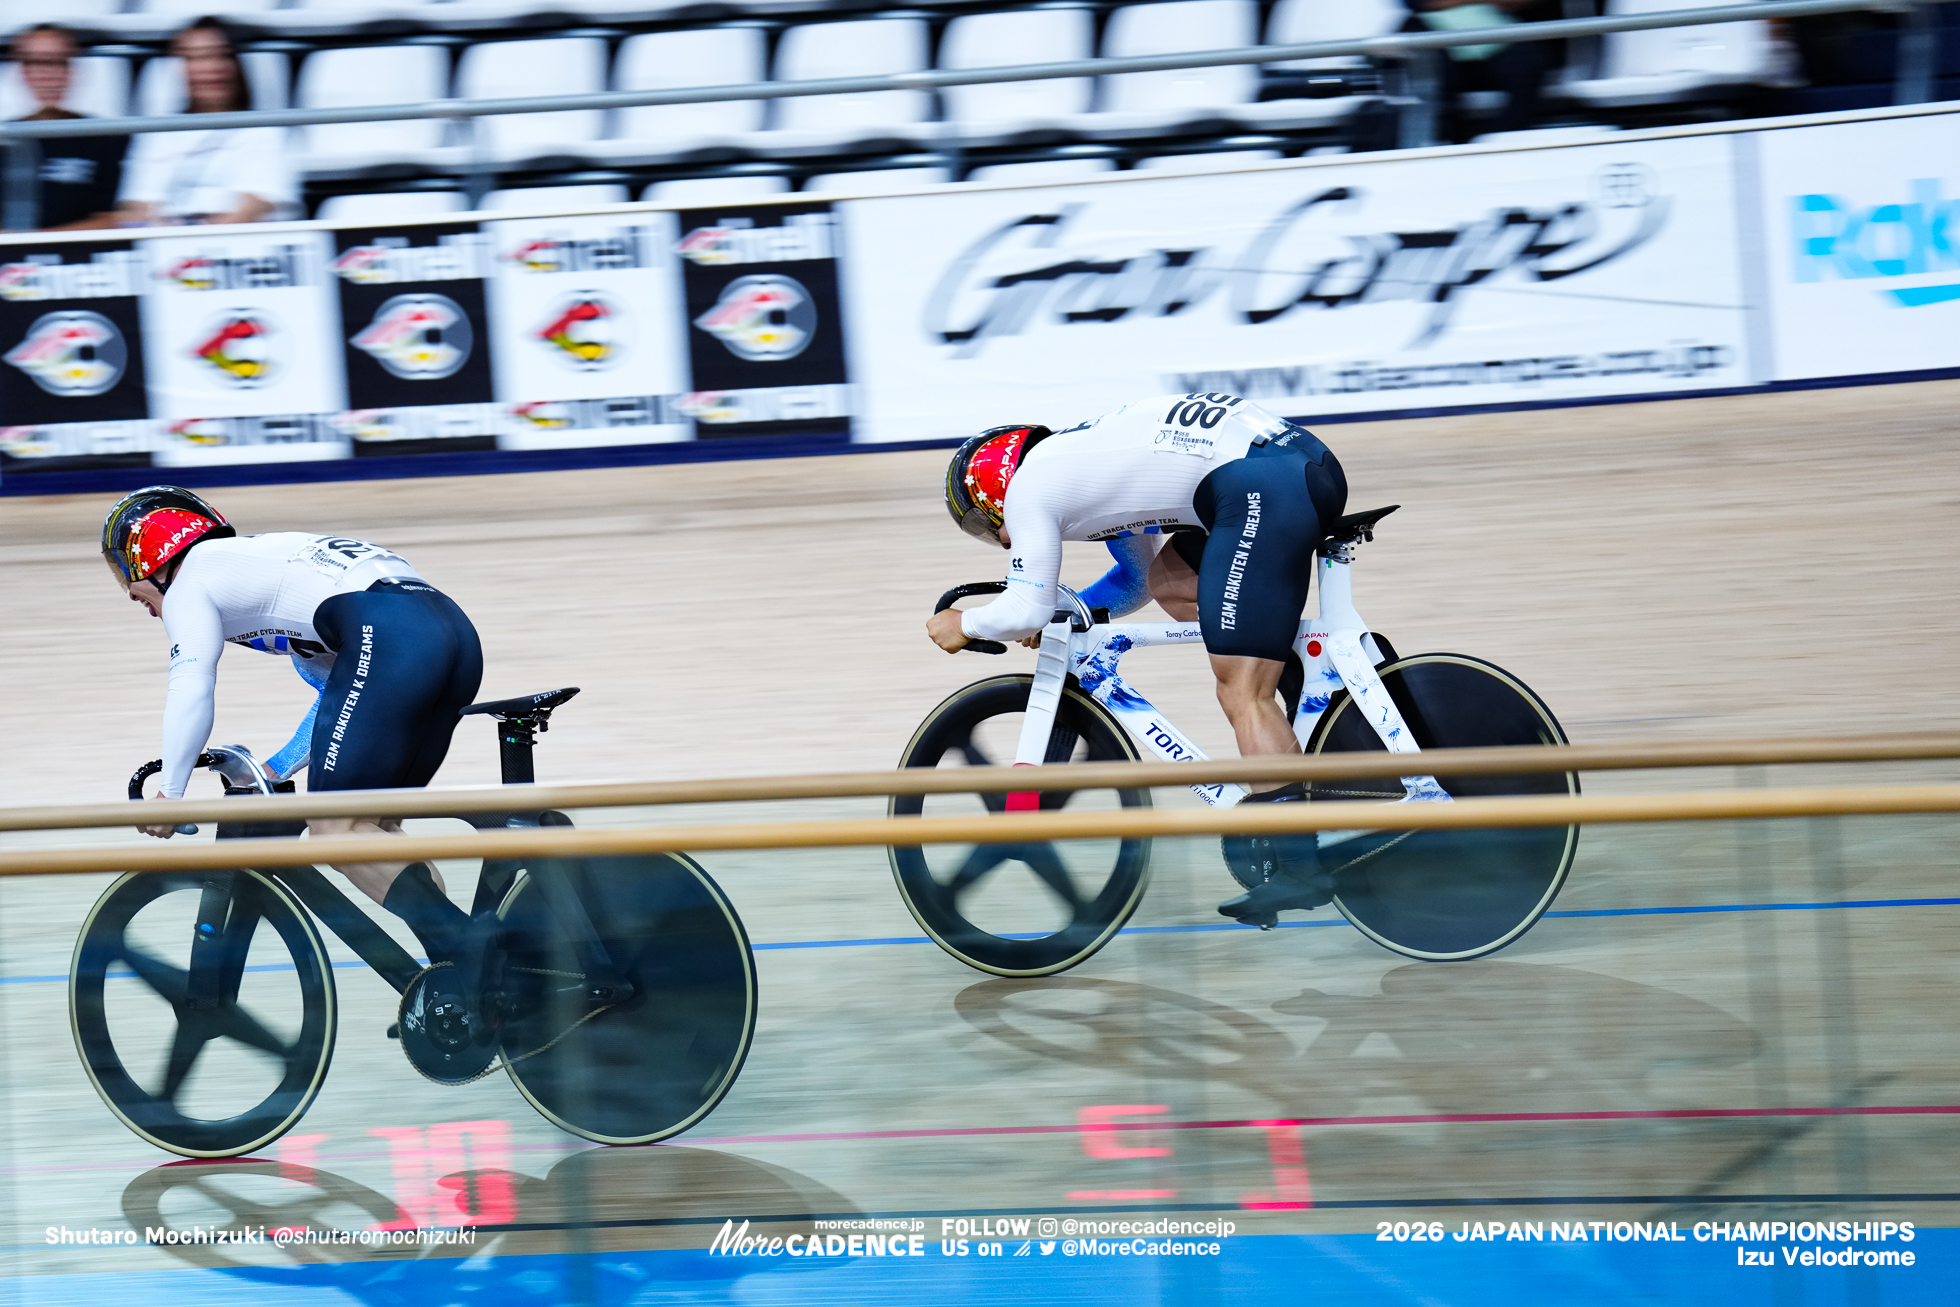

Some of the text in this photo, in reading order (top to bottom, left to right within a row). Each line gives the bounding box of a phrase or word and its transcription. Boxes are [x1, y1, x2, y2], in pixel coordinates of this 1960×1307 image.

[1164, 400, 1227, 429] 100
[998, 434, 1020, 489] JAPAN
[156, 518, 203, 561] JAPAN
[1101, 525, 1126, 535] TRACK
[1126, 519, 1157, 530] CYCLING
[1221, 492, 1261, 631] TEAM RAKUTEN K DREAMS
[237, 631, 259, 641] TRACK
[260, 628, 286, 636] CYCLING
[286, 630, 303, 638] TEAM
[1165, 630, 1182, 639] Toray
[323, 624, 374, 772] TEAM RAKUTEN K DREAMS
